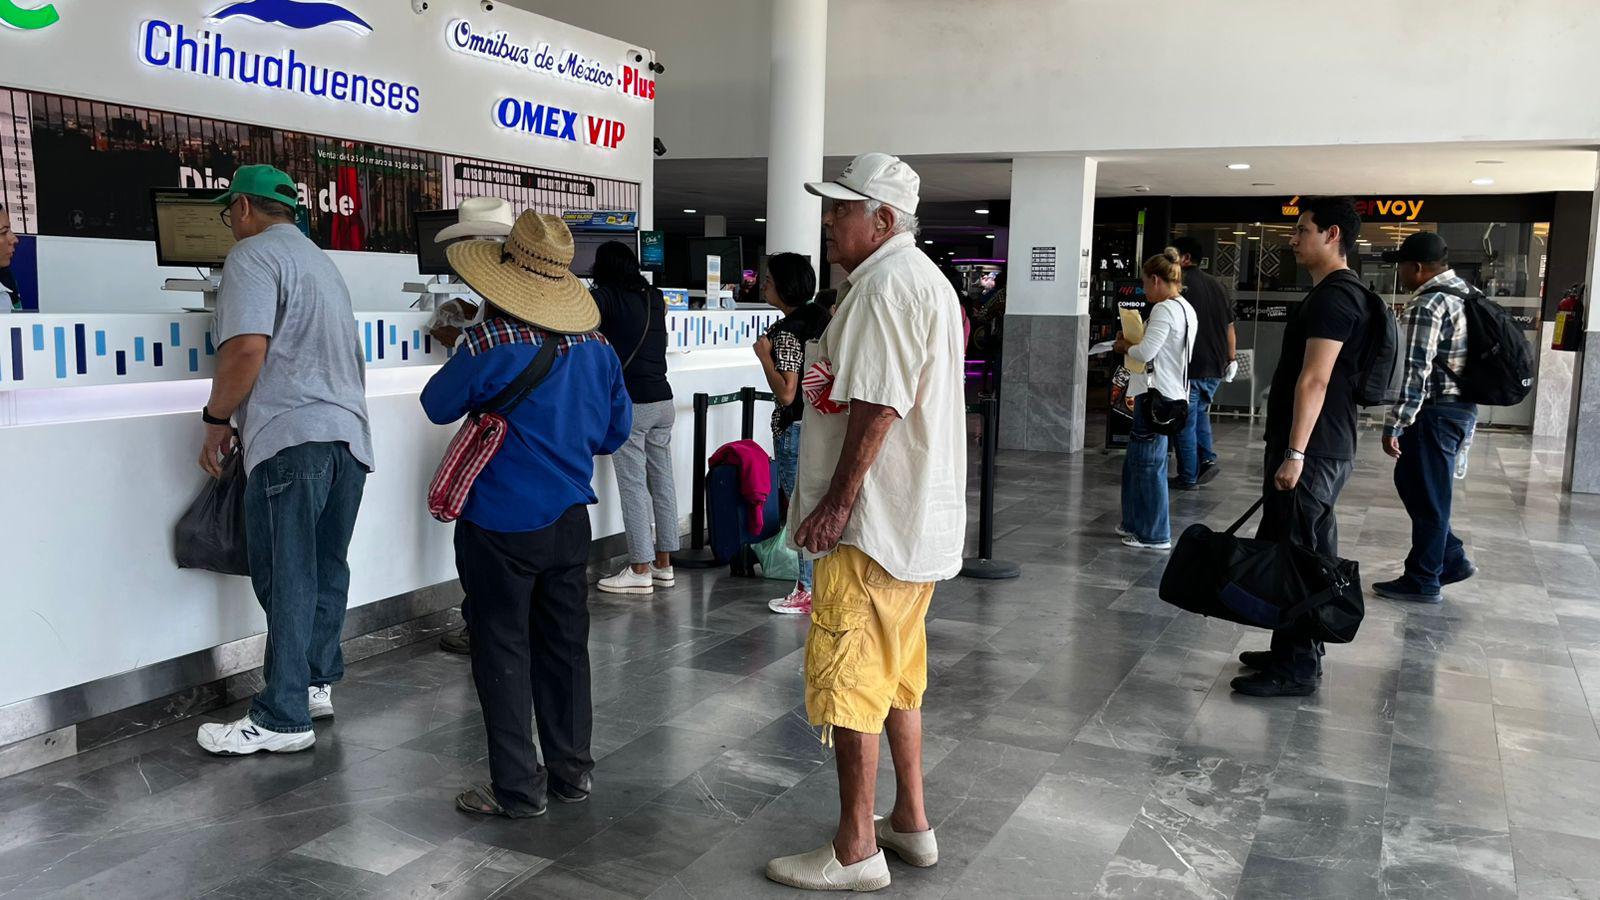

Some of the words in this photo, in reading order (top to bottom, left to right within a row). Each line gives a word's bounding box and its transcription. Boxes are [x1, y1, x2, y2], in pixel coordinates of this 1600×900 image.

[144, 19, 420, 114] Chihuahuenses
[454, 21, 530, 65] Omnibus
[534, 45, 554, 71] de
[557, 52, 614, 87] México
[498, 97, 578, 142] OMEX
[587, 115, 626, 149] VIP
[318, 181, 355, 217] de
[1354, 199, 1425, 221] ervoy
